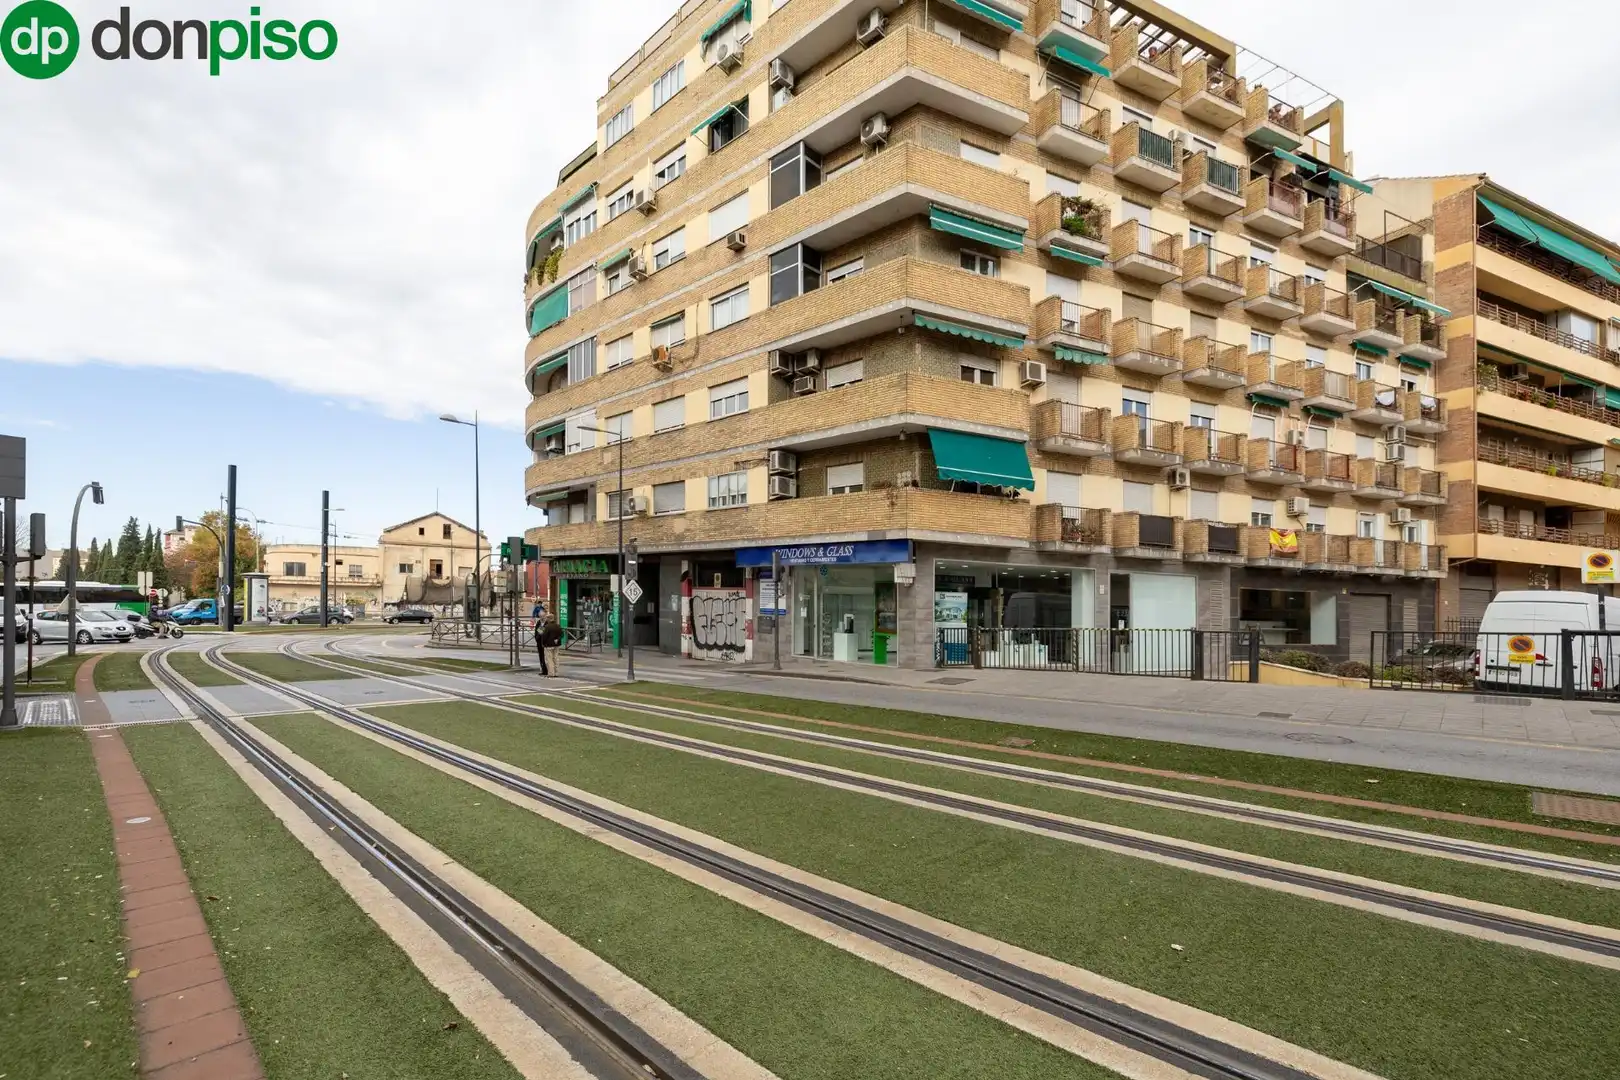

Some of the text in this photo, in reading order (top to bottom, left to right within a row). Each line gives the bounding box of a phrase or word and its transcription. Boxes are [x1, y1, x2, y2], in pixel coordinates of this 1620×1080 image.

[818, 547, 824, 557] &
[826, 545, 854, 557] GLASS
[553, 558, 609, 573] FARMACIA
[629, 588, 638, 597] 15
